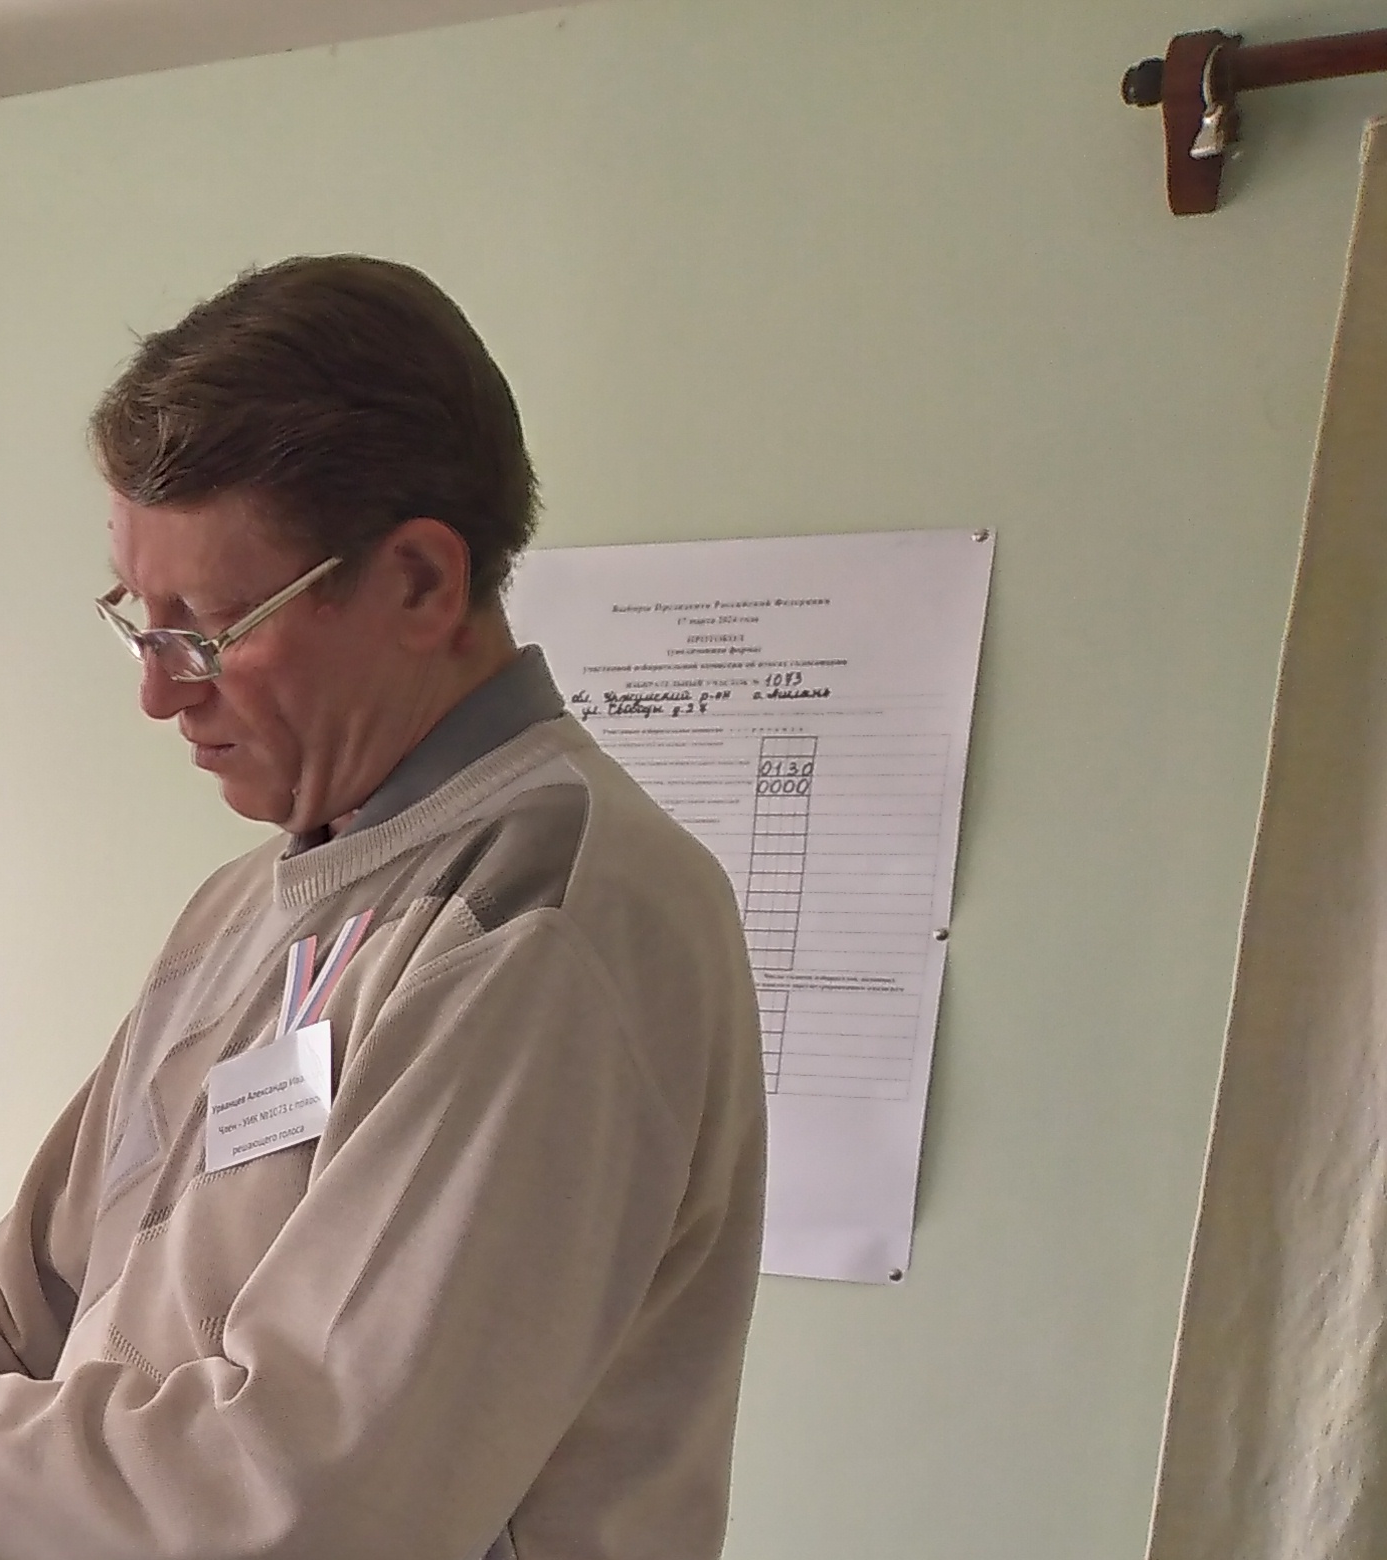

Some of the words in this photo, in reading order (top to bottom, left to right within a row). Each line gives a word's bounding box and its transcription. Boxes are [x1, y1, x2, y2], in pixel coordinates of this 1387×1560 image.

[765, 671, 802, 687] 1073
[761, 761, 813, 776] 0130
[757, 778, 809, 794] 0000
